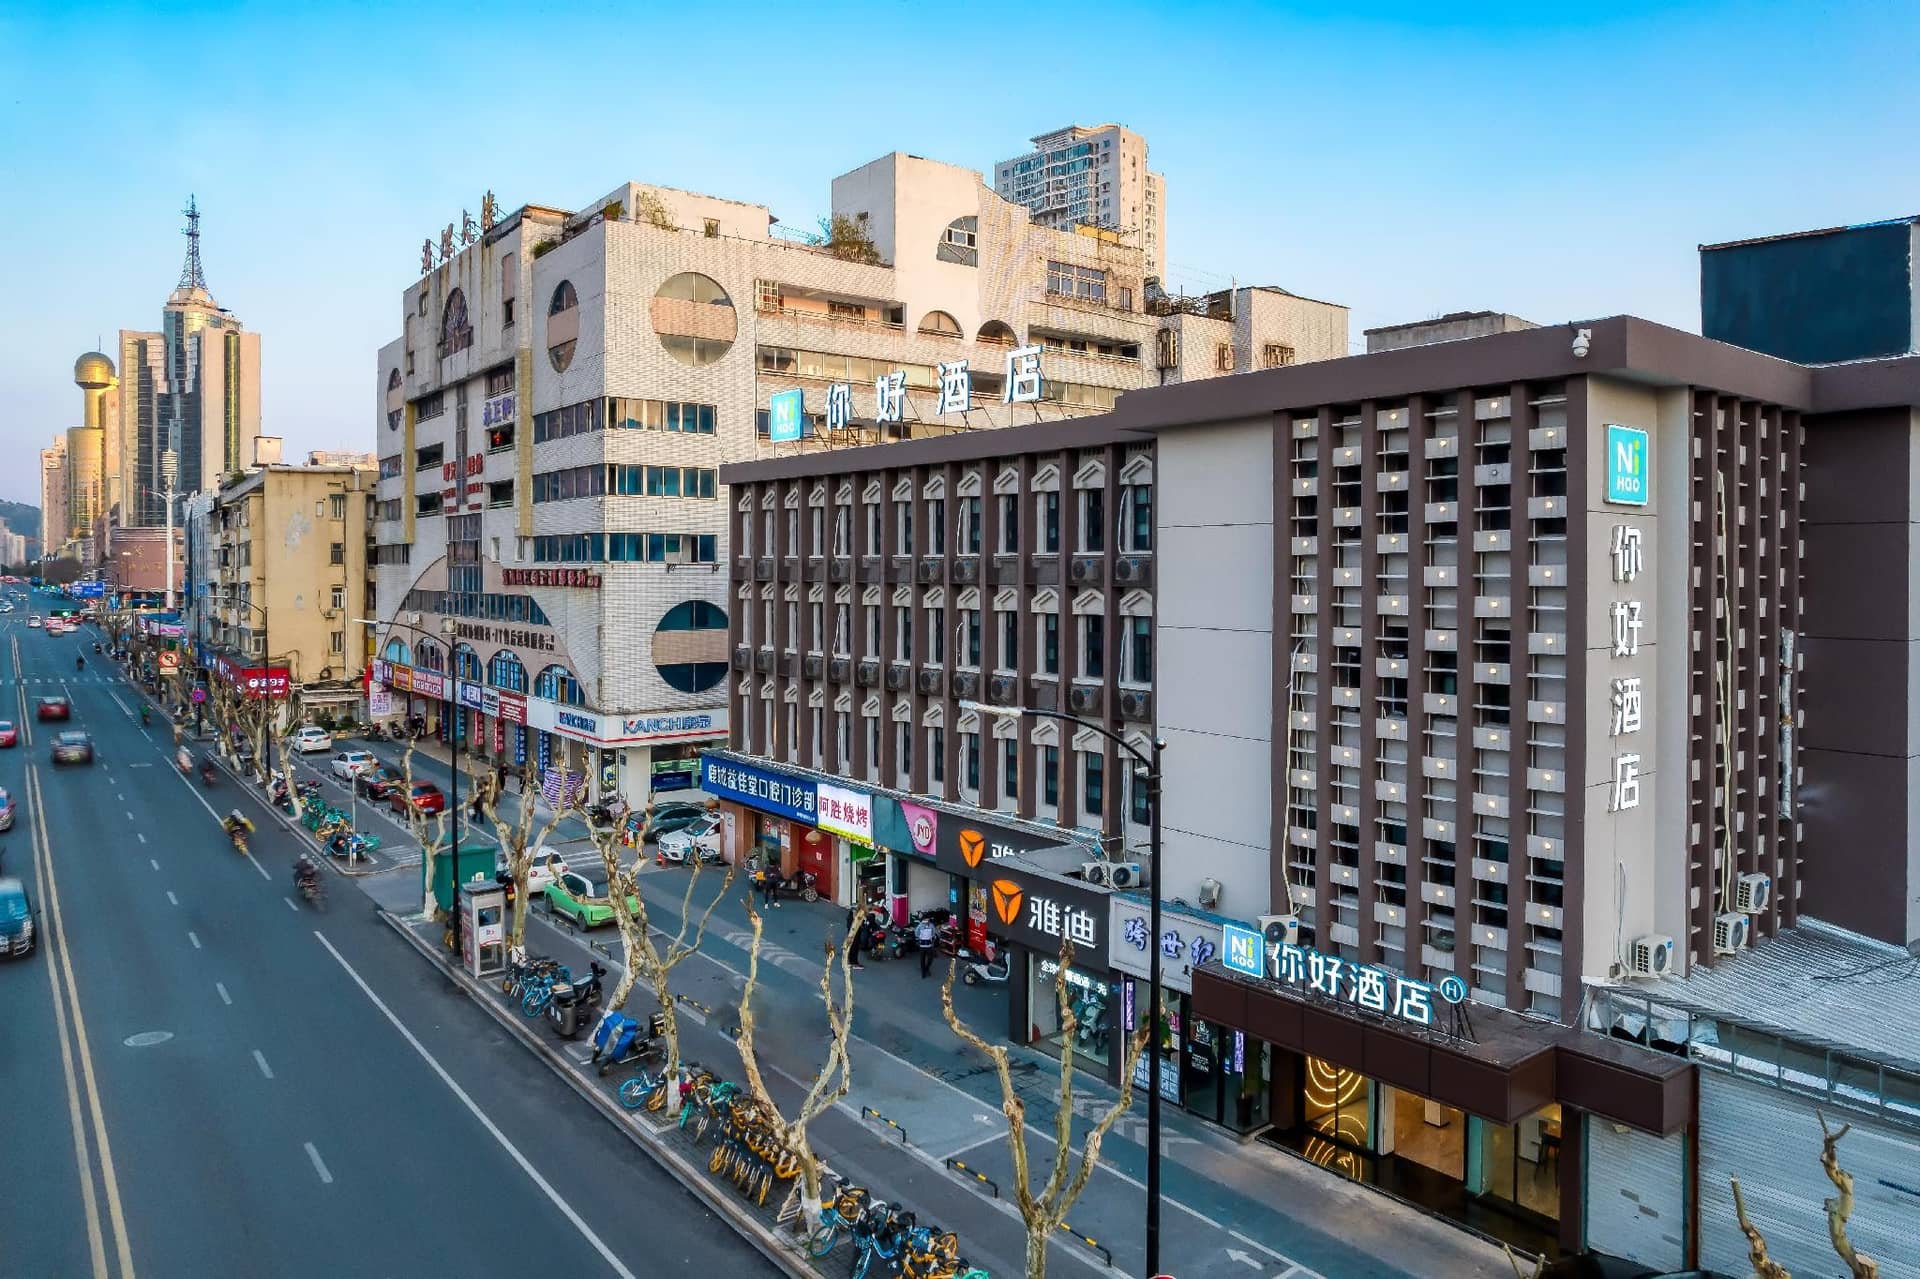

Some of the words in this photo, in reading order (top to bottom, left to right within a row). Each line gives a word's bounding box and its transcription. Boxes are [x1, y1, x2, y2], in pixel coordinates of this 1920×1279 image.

[824, 344, 1043, 431] 你好酒店
[1616, 439, 1641, 475] Ni
[1609, 525, 1642, 812] 你好酒店
[818, 796, 868, 828] 阿胜烧烤
[1028, 896, 1098, 948] 雅迪
[1231, 935, 1254, 959] Ni
[1271, 942, 1432, 1024] 你好酒店
